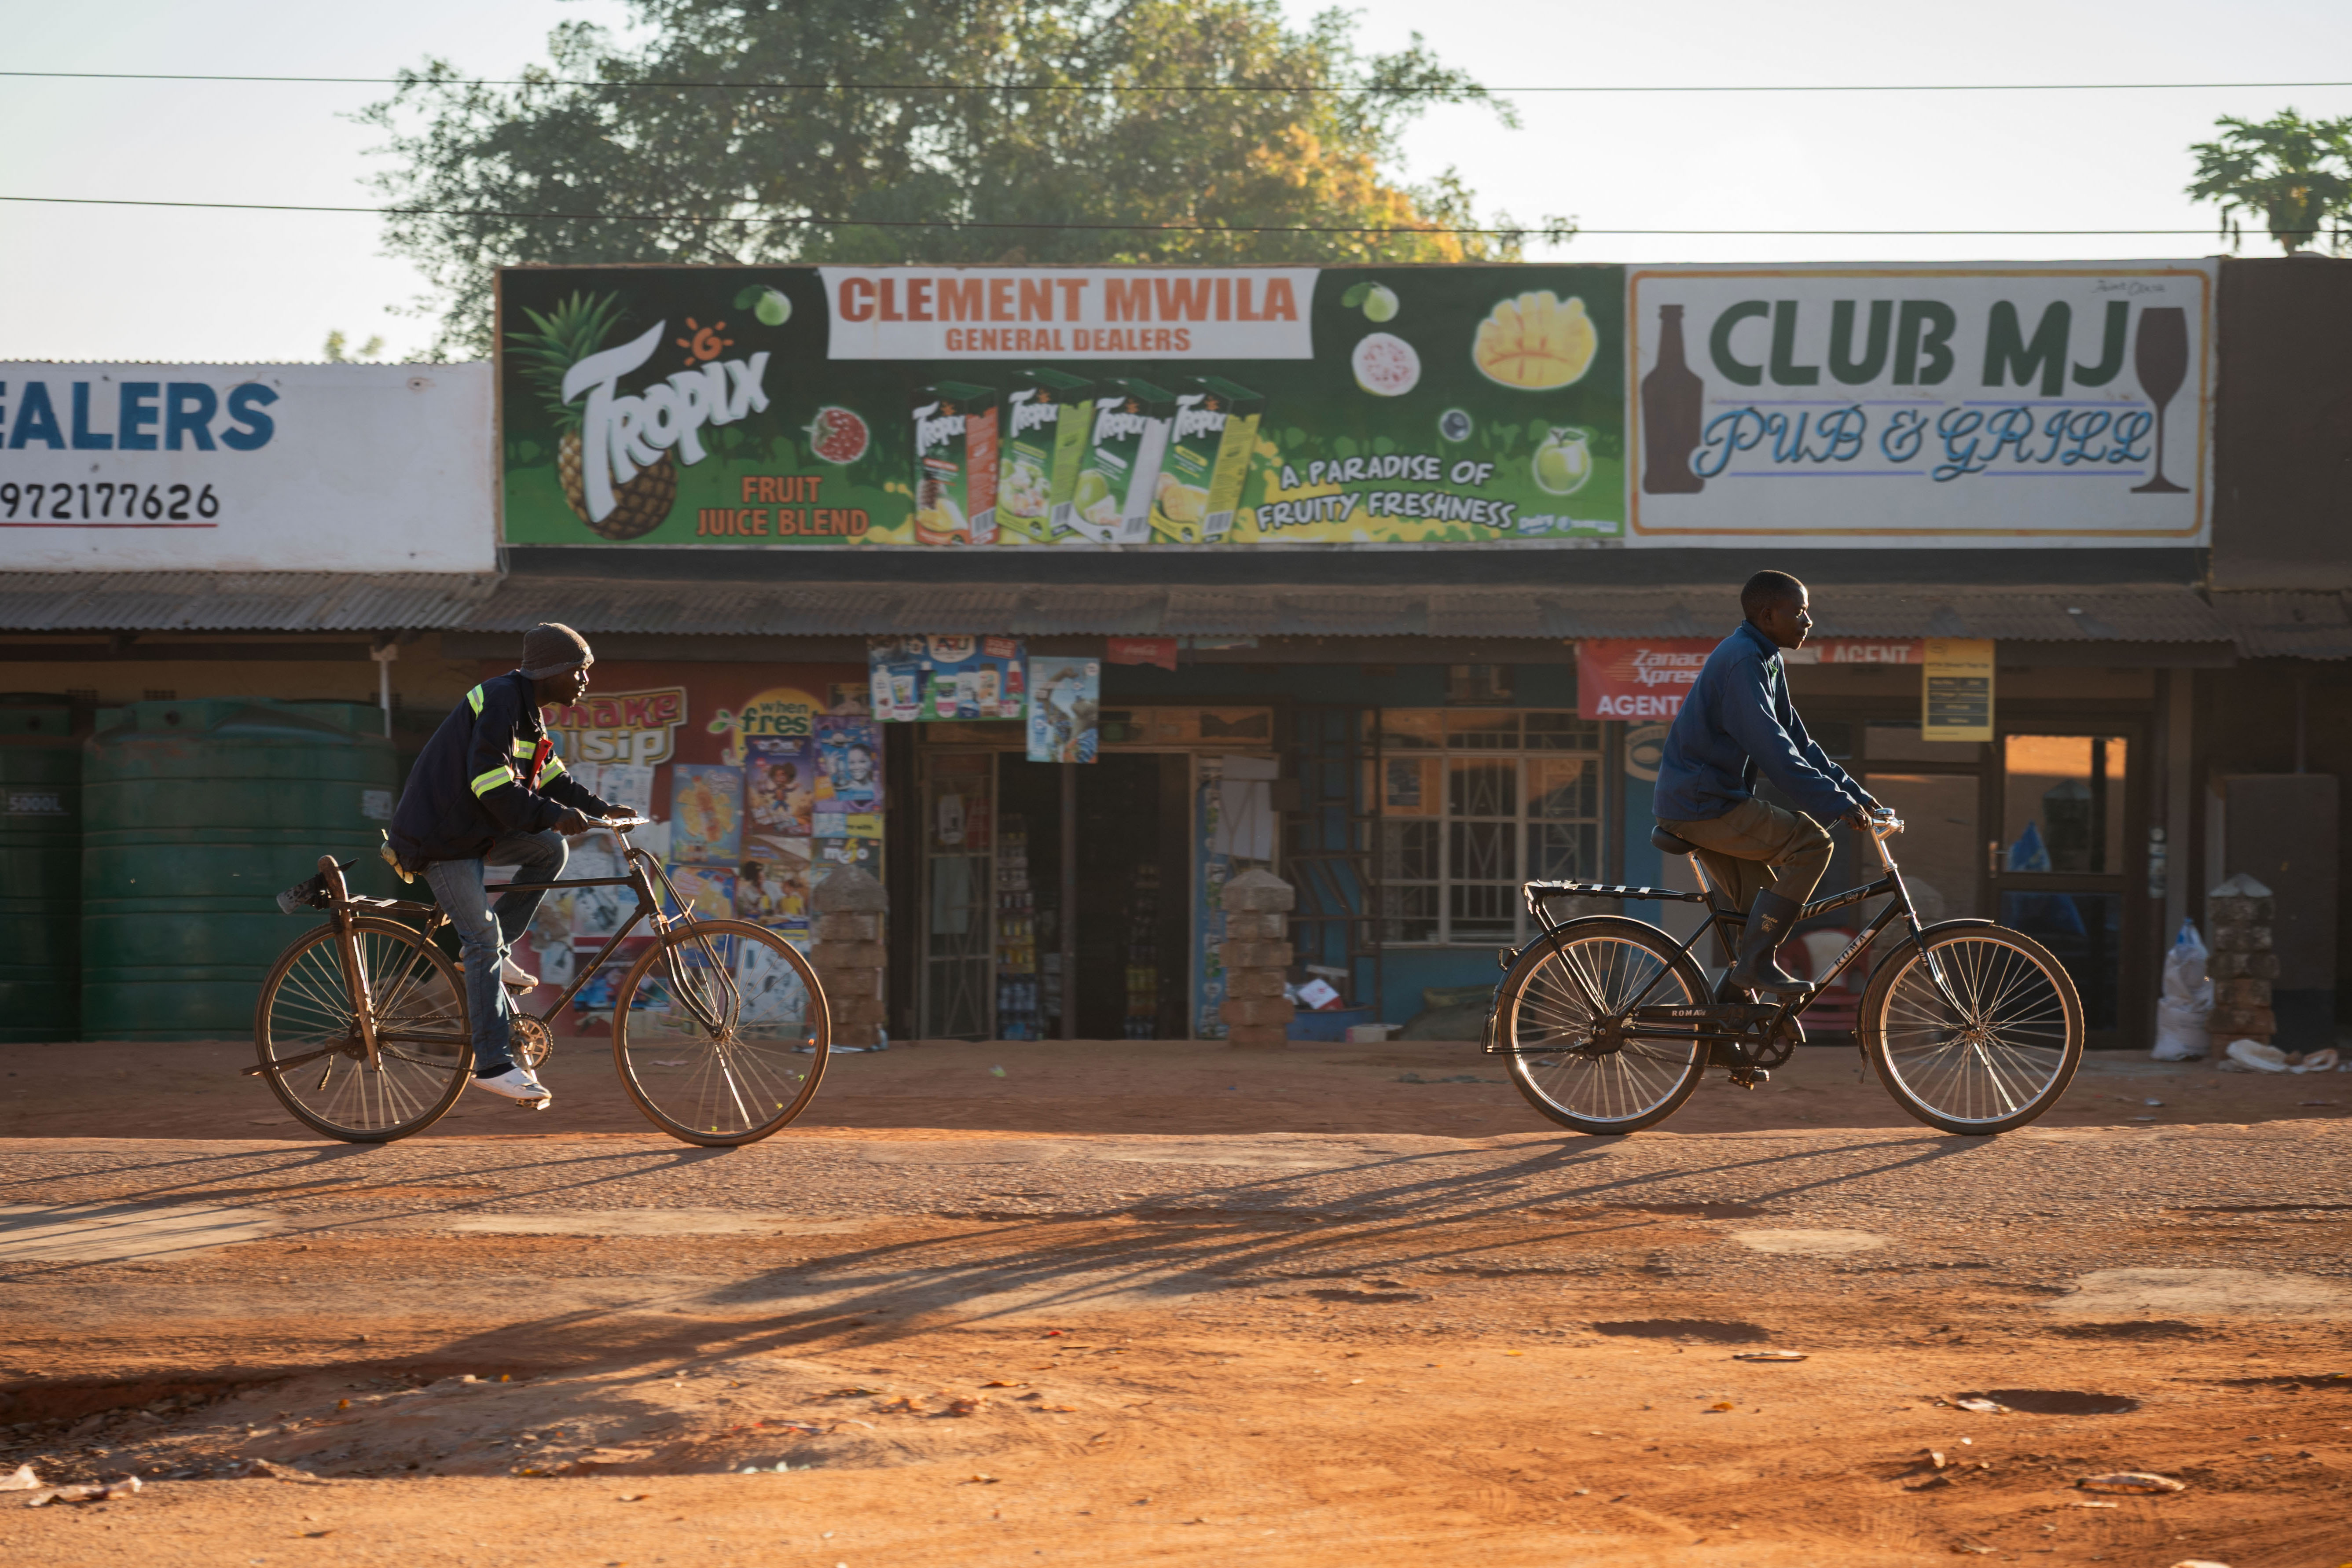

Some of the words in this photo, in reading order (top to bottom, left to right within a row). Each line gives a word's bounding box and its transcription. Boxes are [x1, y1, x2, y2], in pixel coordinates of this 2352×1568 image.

[839, 276, 1089, 322] CLEMENT
[1104, 277, 1298, 322] MWILA
[945, 328, 1065, 351] GENERAL
[1073, 328, 1191, 351] DEALERS
[1708, 300, 1957, 386] CLUB
[1981, 300, 2130, 397] MJ
[0, 382, 279, 451] ALERS
[1693, 404, 1867, 477] PUB
[1880, 407, 1930, 462] &
[1931, 406, 2153, 482] GRILL
[1280, 466, 1300, 491] A
[1309, 455, 1442, 485] PARADISE
[1450, 461, 1494, 486] OF
[741, 476, 822, 503] FRUIT
[697, 508, 768, 536] JUICE
[778, 509, 869, 536] BLEND
[1255, 492, 1360, 531] FRUITY
[1367, 491, 1518, 530] FRESHNESS
[1834, 644, 1912, 663] AGENT
[760, 700, 808, 714] when
[1596, 695, 1683, 716] AGENT
[740, 707, 818, 734] fres
[1834, 934, 1867, 968] ROMA
[1917, 947, 1929, 967] ROMA
